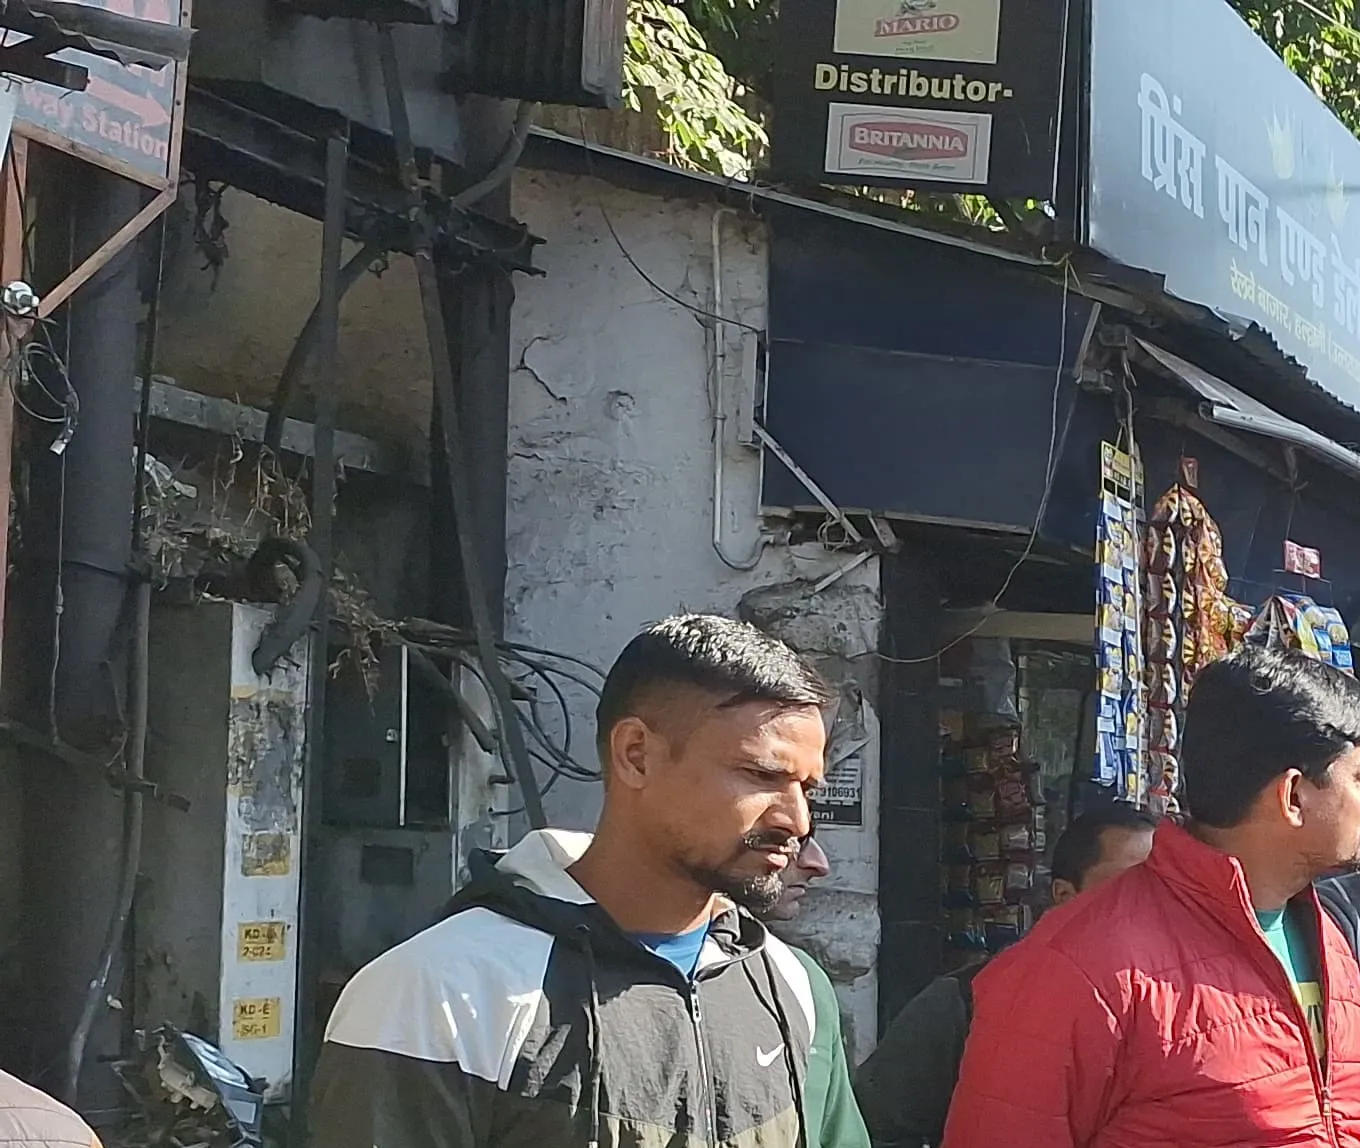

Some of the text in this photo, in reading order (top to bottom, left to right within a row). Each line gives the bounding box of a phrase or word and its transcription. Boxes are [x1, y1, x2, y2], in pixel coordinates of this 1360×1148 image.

[879, 15, 956, 36] MARIO
[814, 62, 1013, 102] Distributor-
[81, 104, 168, 160] Station
[854, 127, 965, 152] BRITANNIA
[1137, 72, 1207, 219] प्रिंस
[1214, 153, 1270, 267] पान
[1276, 205, 1327, 310] एण्ड
[1229, 257, 1256, 306] रेलवे
